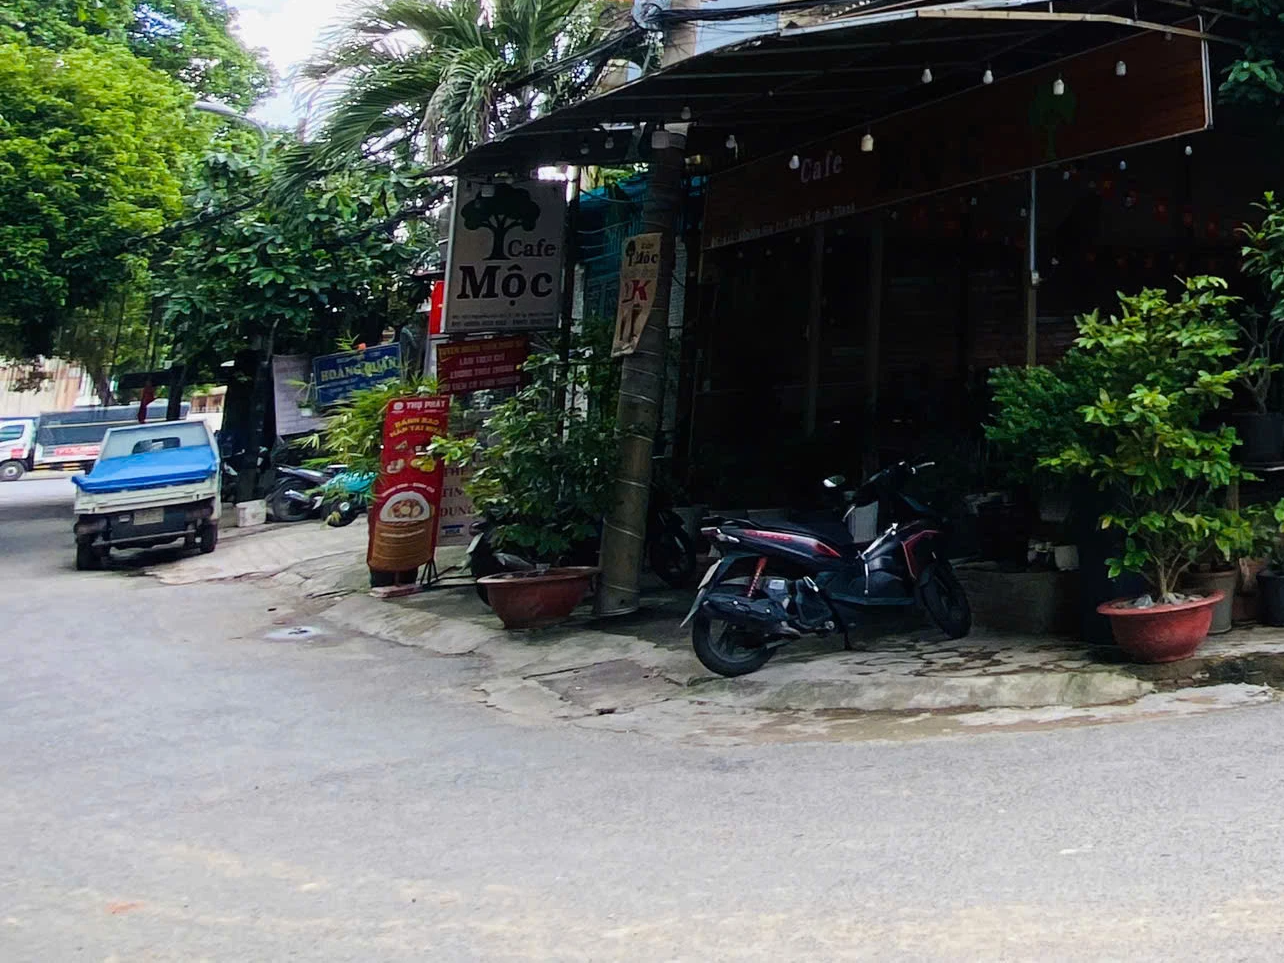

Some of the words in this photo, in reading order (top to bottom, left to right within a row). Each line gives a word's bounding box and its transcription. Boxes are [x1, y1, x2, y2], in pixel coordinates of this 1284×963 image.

[800, 150, 842, 183] Cafe
[507, 238, 556, 257] Cafe
[456, 264, 553, 307] Mộc
